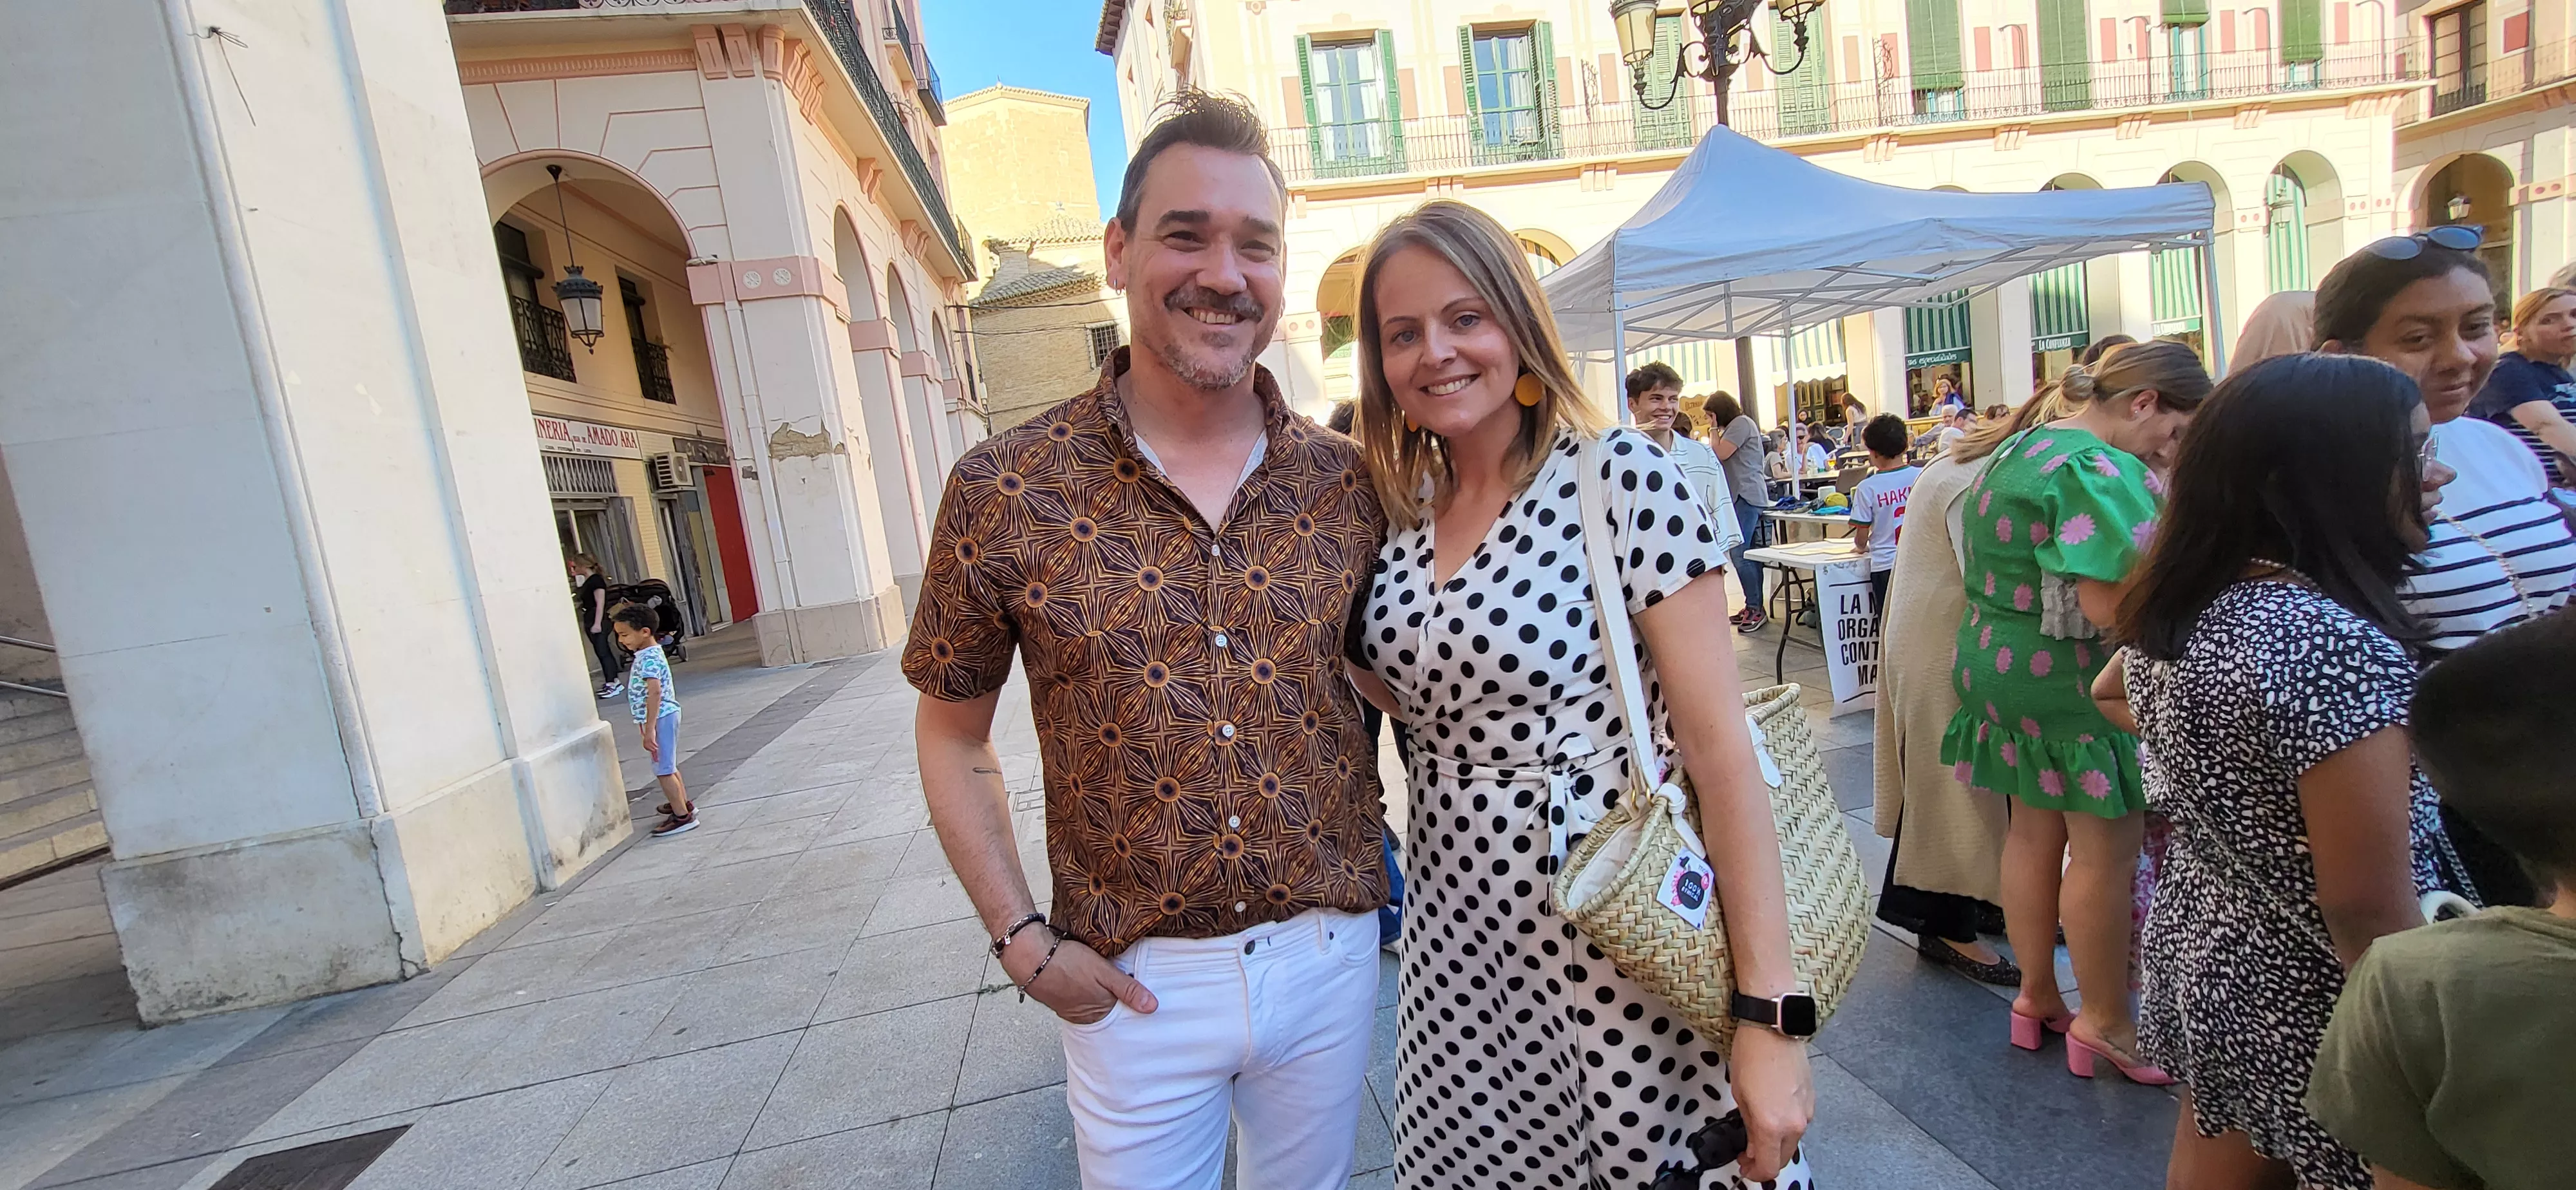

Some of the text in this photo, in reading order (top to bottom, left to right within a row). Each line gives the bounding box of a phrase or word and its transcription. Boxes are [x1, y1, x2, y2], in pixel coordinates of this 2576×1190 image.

[2039, 337, 2071, 350] LA CONFIANZA
[587, 426, 618, 447] AMADO
[620, 430, 638, 449] ARA
[1840, 593, 1861, 615] LA
[1837, 612, 1880, 641] ORGÁ
[1841, 641, 1879, 666] CONT
[1857, 663, 1877, 687] MA
[1684, 878, 1701, 896] 100%
